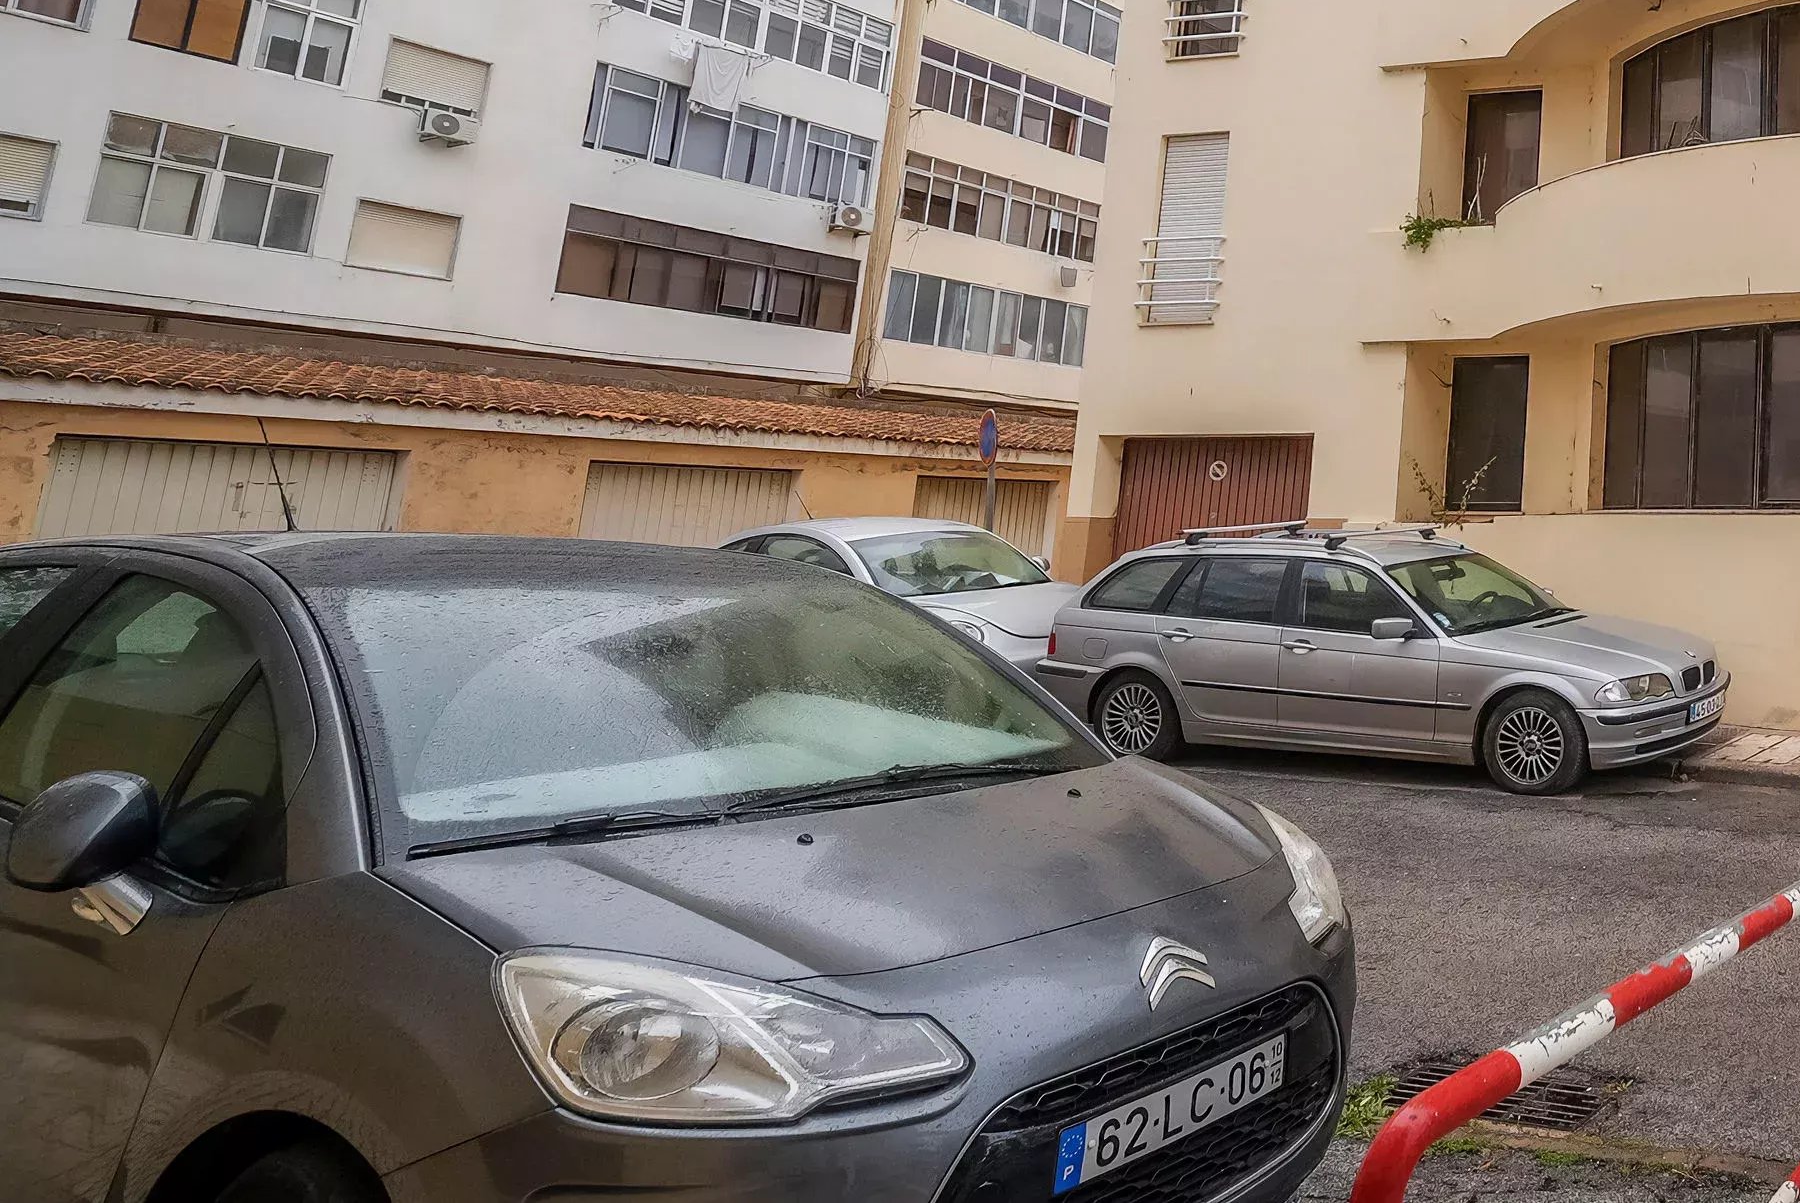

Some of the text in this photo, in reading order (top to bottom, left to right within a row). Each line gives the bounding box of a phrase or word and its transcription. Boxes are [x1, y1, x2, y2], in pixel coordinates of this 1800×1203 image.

[1271, 1041, 1283, 1057] 10
[1270, 1067, 1281, 1085] 12
[1062, 1164, 1075, 1181] P
